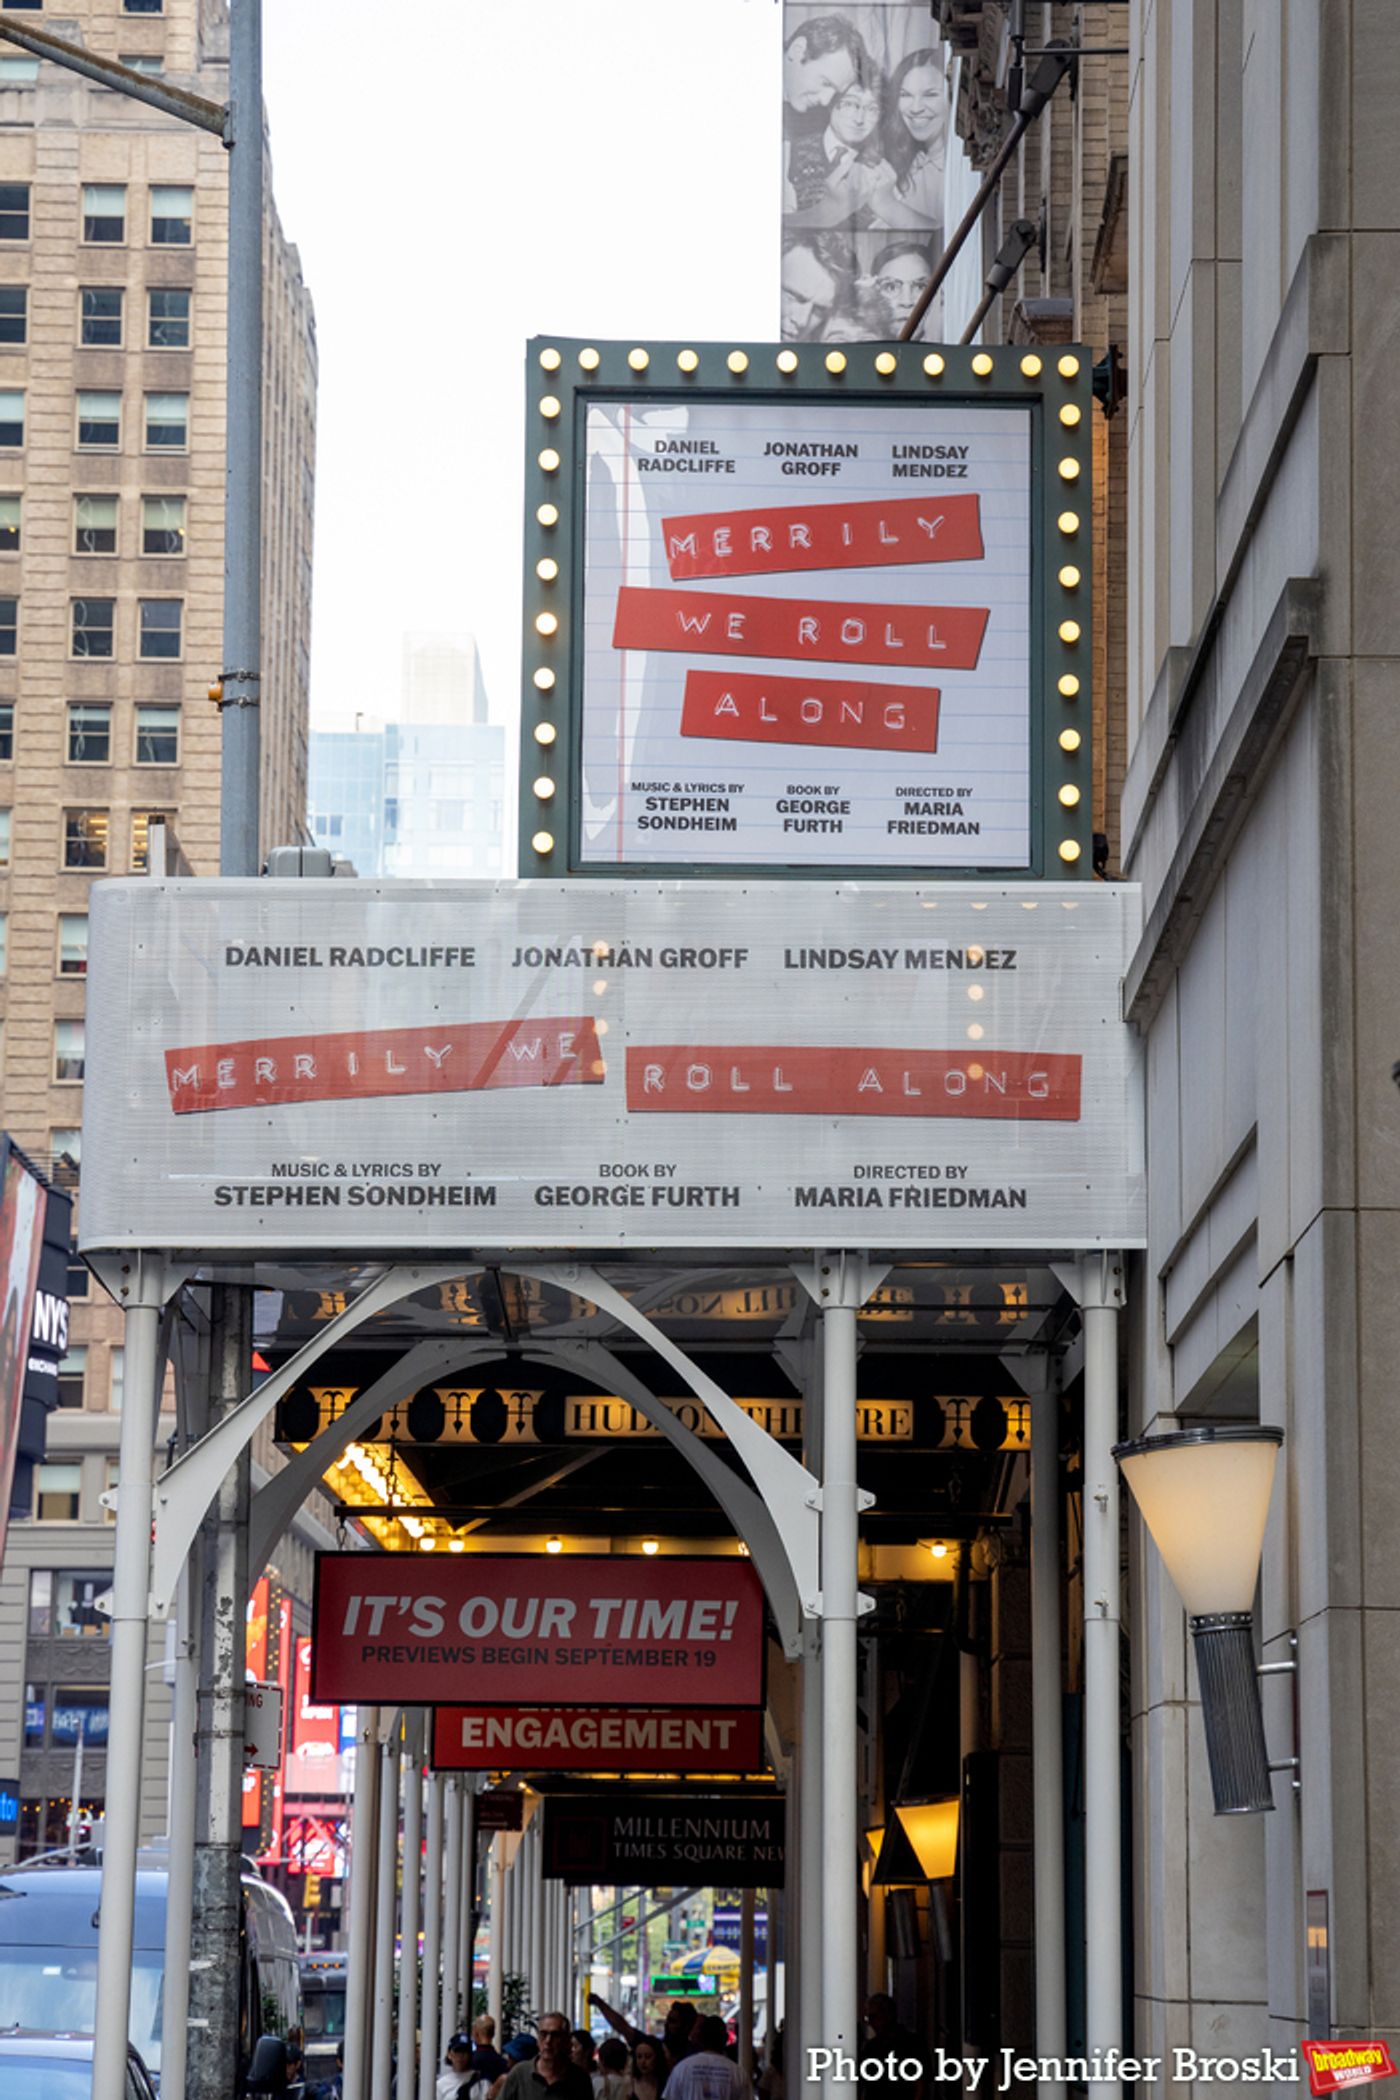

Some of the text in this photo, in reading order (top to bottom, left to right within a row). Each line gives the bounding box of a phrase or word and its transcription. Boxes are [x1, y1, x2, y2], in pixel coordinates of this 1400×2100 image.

[655, 440, 720, 455] DANIEL
[763, 442, 859, 458] JONATHAN
[892, 445, 969, 460] LINDSAY
[637, 458, 736, 474] RADCLIFFE
[781, 461, 841, 477] GROFF
[892, 463, 968, 478] MENDEZ
[669, 514, 945, 560] MERRILY
[678, 612, 947, 651] WE ROLL
[713, 691, 906, 730] ALONG
[630, 781, 745, 794] MUSIC & LYRICS BY
[786, 784, 841, 796] BOOK BY
[895, 786, 974, 798] DIRECTED BY
[645, 796, 730, 812] STEPHEN
[775, 799, 851, 815] GEORGE
[904, 802, 964, 817] MARIA
[637, 815, 737, 831] SONDHEIM
[783, 818, 843, 834] FURTH
[887, 820, 980, 836] FRIEDMAN
[225, 946, 476, 968] DANIEL RADCLIFFE
[511, 946, 749, 969] JONATHAN GROFF
[784, 948, 1017, 970] LINDSAY MENDEZ
[171, 1032, 578, 1092] MERRILY WE
[643, 1062, 1050, 1099] ROLL ALONG
[271, 1163, 442, 1178] MUSIC & LYRICS BY
[599, 1163, 678, 1178] BOOK BY
[853, 1164, 969, 1180] DIRECTED BY
[214, 1185, 497, 1207] STEPHEN SONDHEIM
[534, 1185, 740, 1207] GEORGE FURTH
[795, 1187, 1027, 1209] MARIA FRIEDMAN
[572, 1403, 724, 1433] HUDON
[342, 1596, 739, 1641] IT'S OUR TIME!
[361, 1646, 716, 1668] PREVIEWS BEGIN SEPTEMBER 19
[461, 1717, 737, 1750] ENGAGEMENT
[614, 1816, 771, 1840] MILLENNIUM
[613, 1842, 667, 1859] TIMES
[673, 1843, 746, 1863] SQUARE
